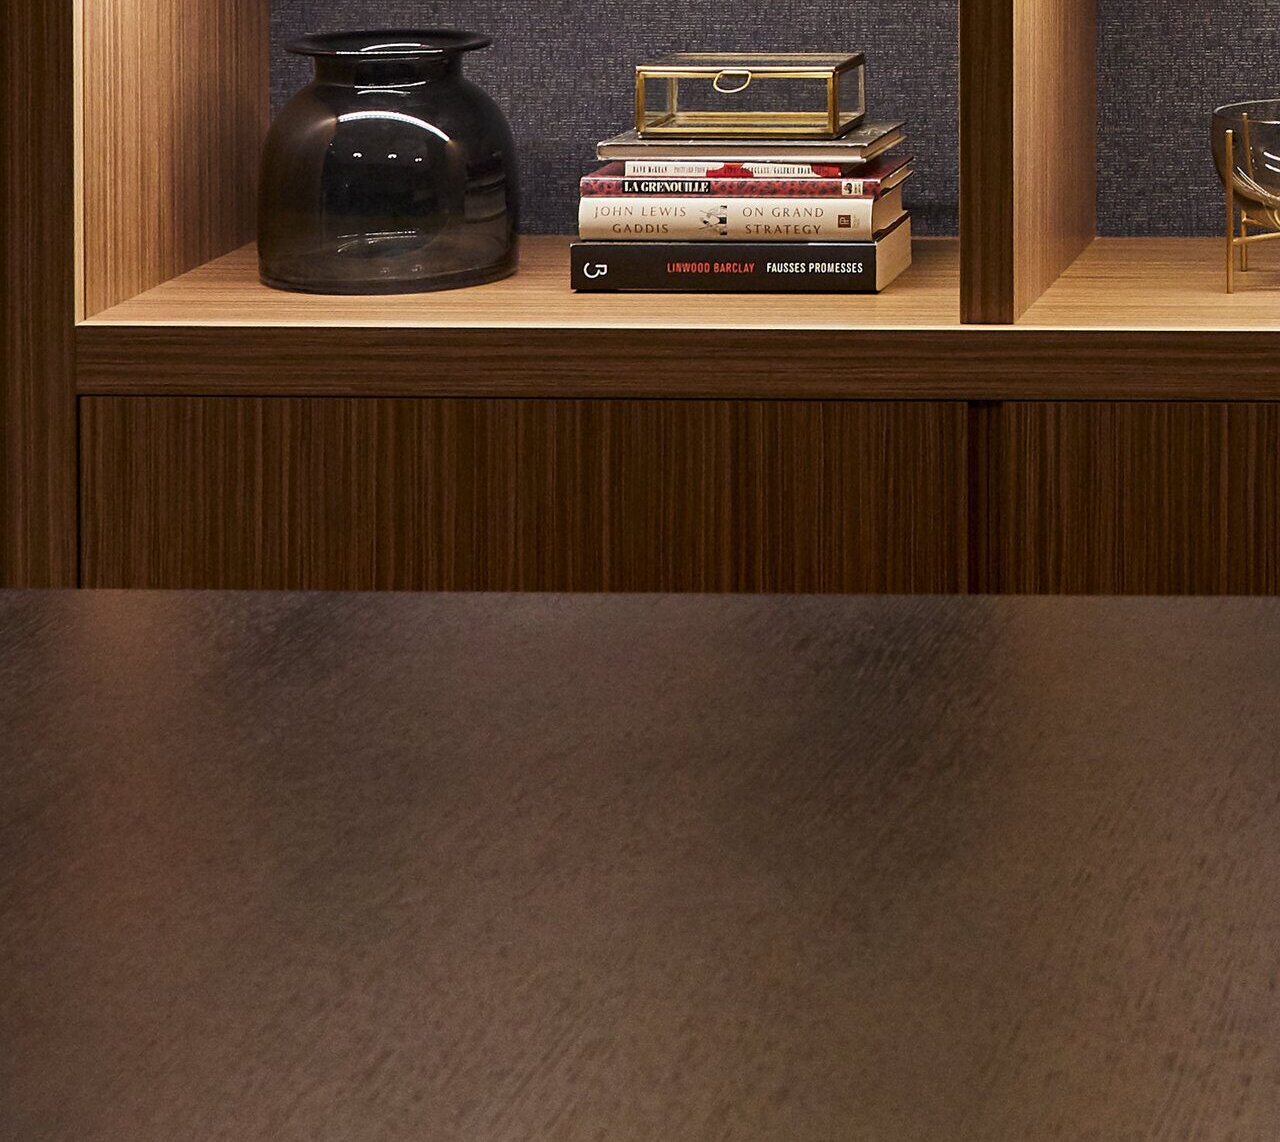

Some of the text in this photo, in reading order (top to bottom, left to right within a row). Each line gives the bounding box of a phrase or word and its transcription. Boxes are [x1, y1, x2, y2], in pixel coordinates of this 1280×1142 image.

[624, 181, 709, 193] LA GRENOUILLE
[594, 206, 687, 219] JOHN LEWIS
[742, 207, 825, 218] ON GRAND
[612, 223, 669, 234] GADDIS
[744, 224, 822, 235] STRATEGY
[667, 262, 755, 273] LINWOOD BARCLAY
[766, 262, 864, 273] FAUSSES PROMESSES
